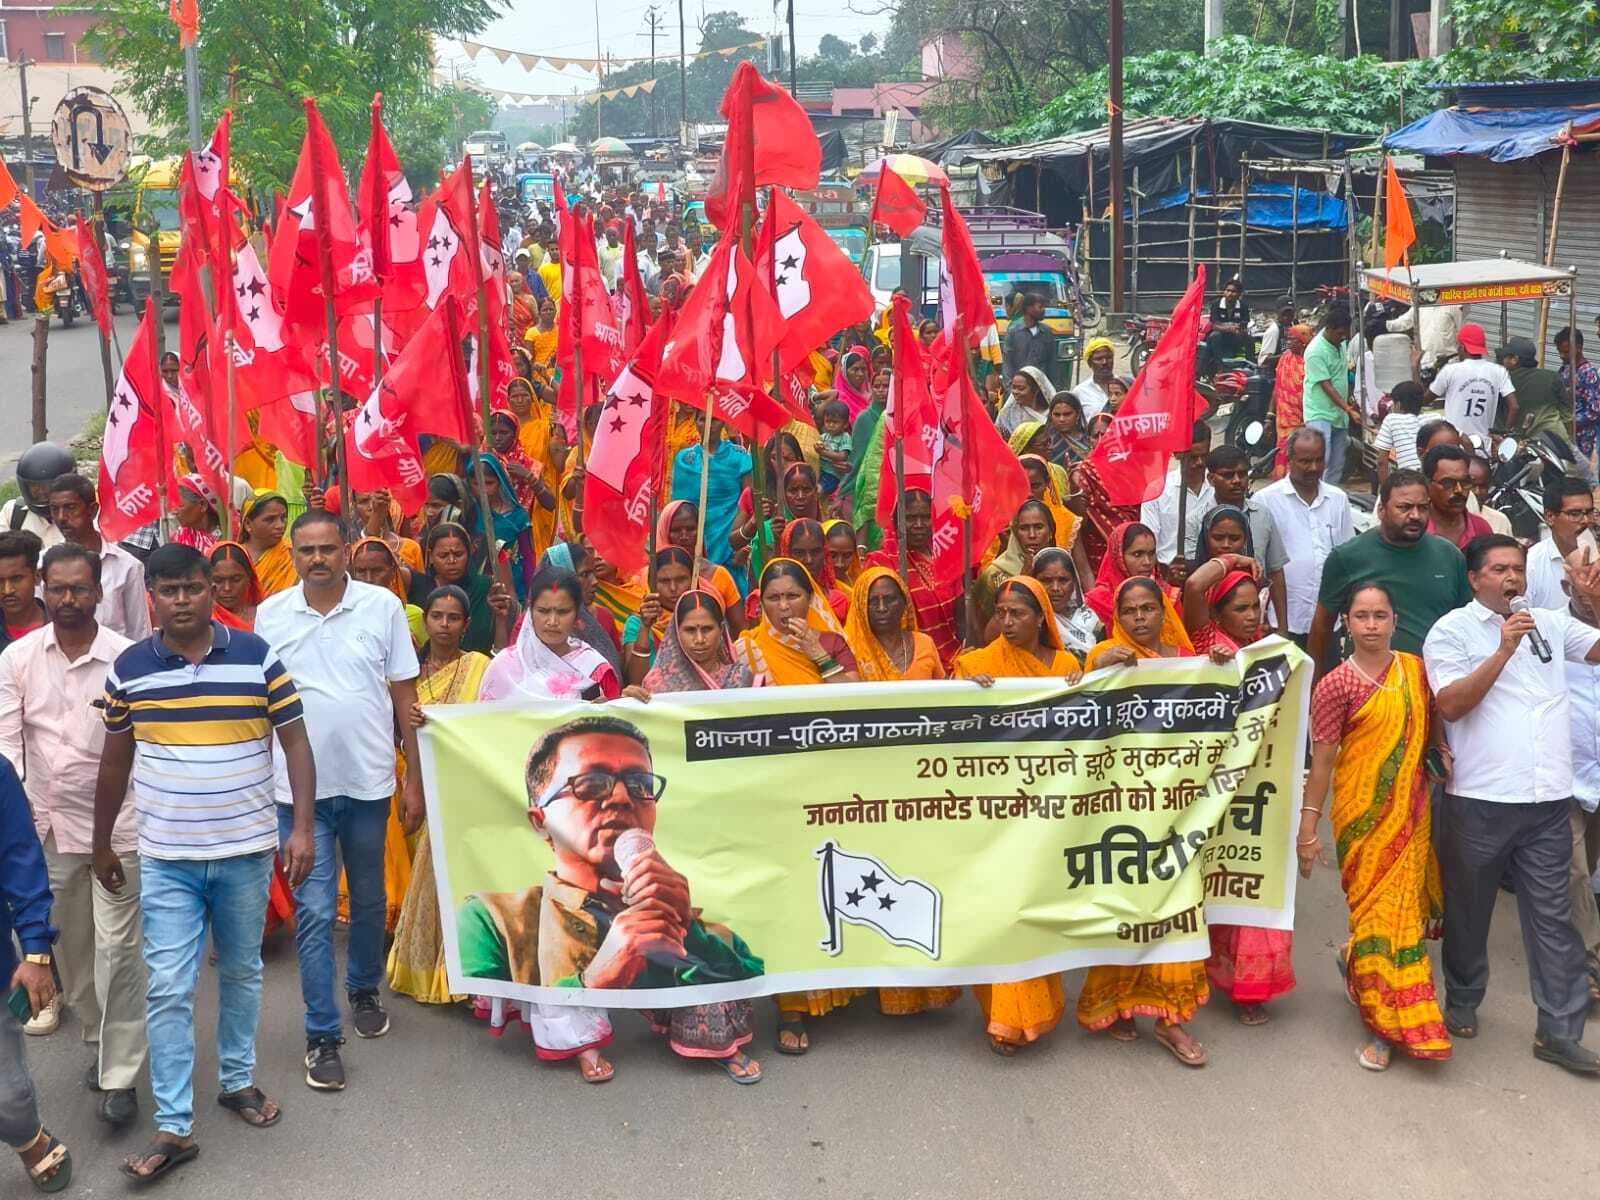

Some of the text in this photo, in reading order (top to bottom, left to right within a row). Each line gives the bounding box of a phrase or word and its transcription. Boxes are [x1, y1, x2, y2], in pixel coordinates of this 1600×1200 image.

[1464, 398, 1487, 417] 15
[695, 727, 773, 748] भाजपा
[864, 715, 947, 740] गठजोड़
[951, 714, 985, 732] को
[989, 706, 1049, 729] ध्वस्त
[1053, 699, 1102, 728] करो
[1115, 694, 1150, 729] झूठे
[1152, 692, 1231, 729] मुकदमें
[916, 757, 949, 779] 20
[952, 755, 1009, 779] साल
[1014, 748, 1079, 785] पुराने
[1084, 745, 1116, 781] झूठे
[1121, 739, 1203, 778] मुकदमें
[803, 793, 888, 827] जननेता
[892, 789, 974, 821] कामरेड
[976, 787, 1067, 820] परमेश्वर
[1071, 781, 1123, 817] महतो
[1126, 780, 1157, 811] को
[1216, 844, 1262, 862] 2025
